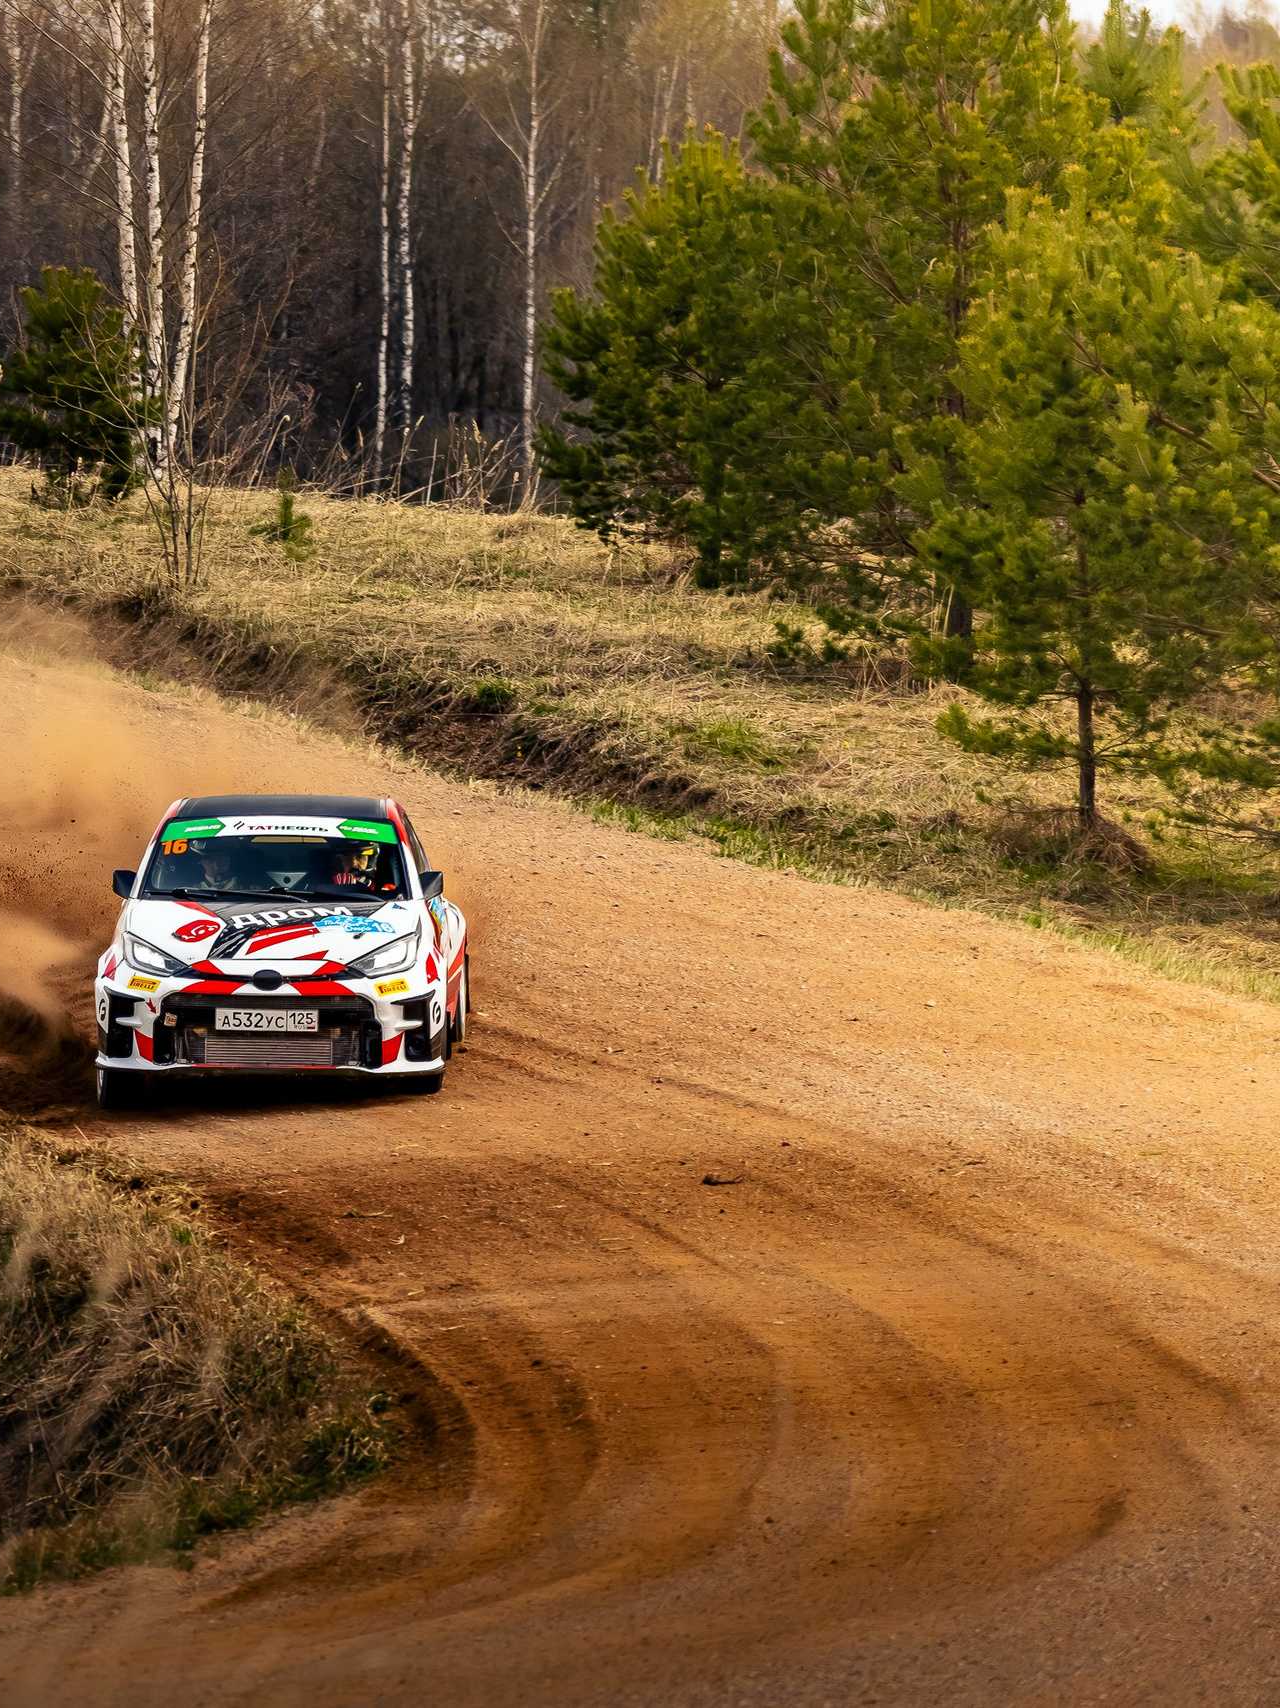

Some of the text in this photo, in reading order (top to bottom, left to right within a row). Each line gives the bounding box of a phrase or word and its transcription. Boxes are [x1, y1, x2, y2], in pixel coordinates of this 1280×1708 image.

[161, 838, 188, 855] 16
[372, 922, 394, 933] 16
[129, 978, 157, 990] PIRELLI
[378, 981, 407, 994] PIRELLI
[289, 1012, 313, 1025] 125
